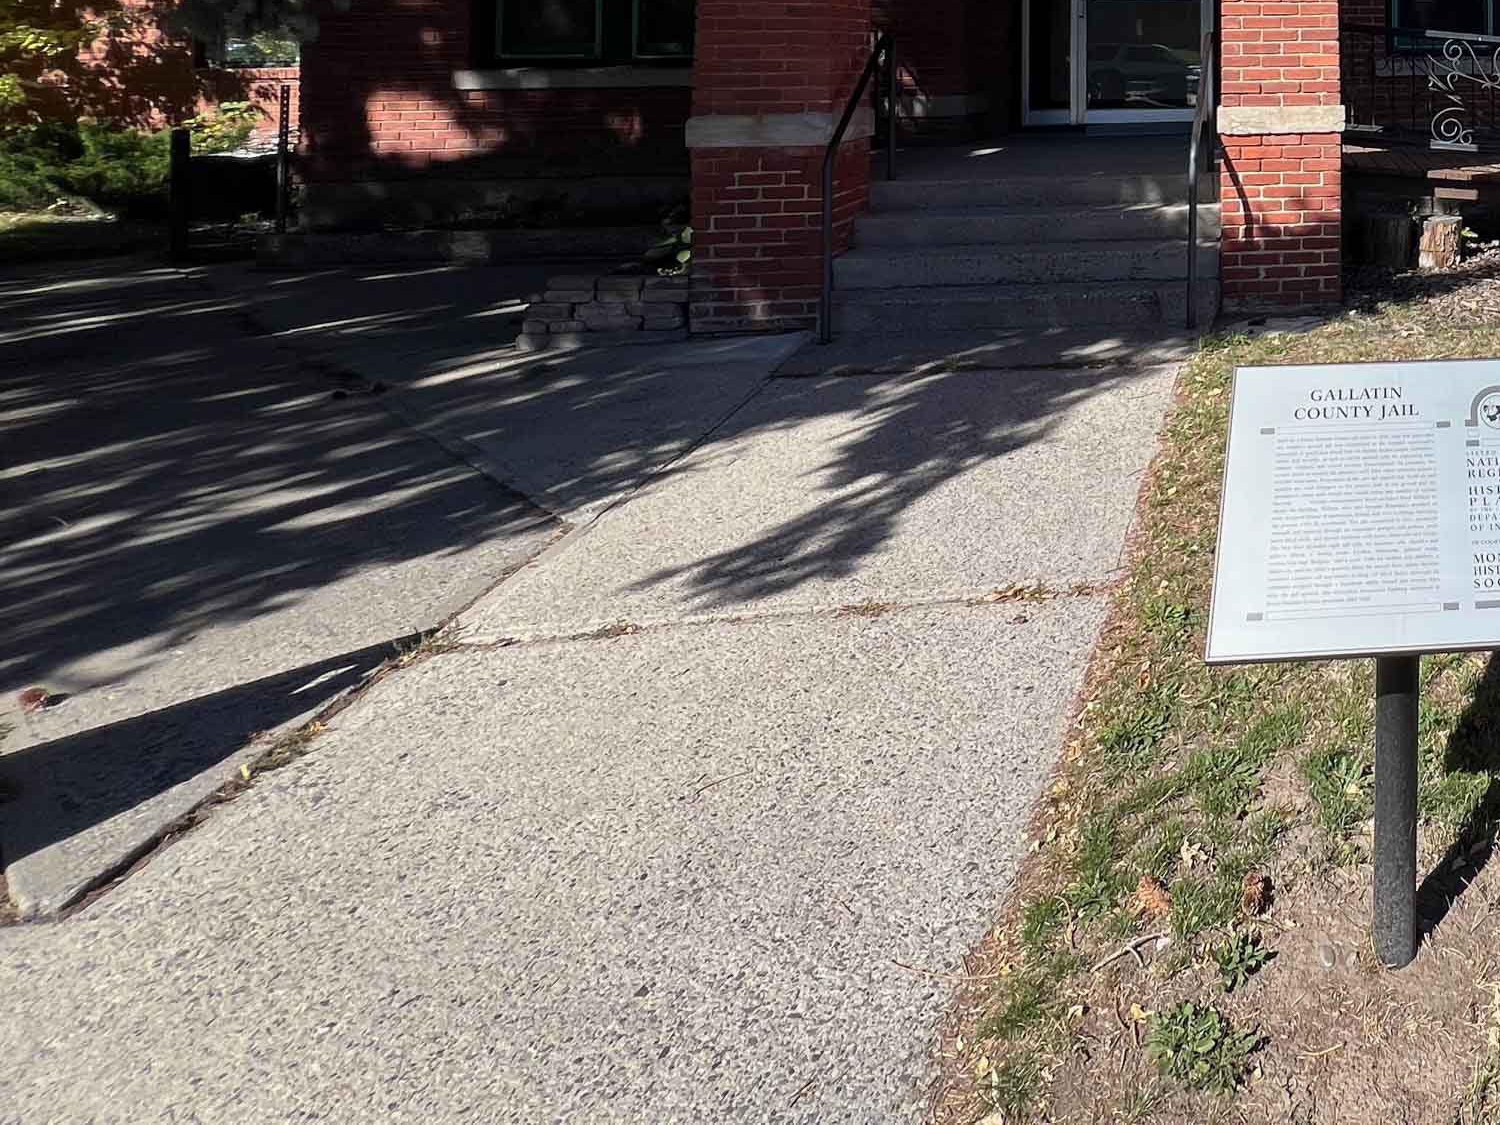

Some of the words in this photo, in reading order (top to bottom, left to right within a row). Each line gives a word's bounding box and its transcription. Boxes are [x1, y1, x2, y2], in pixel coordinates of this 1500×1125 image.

[1310, 386, 1402, 402] GALLATIN
[1294, 405, 1375, 420] COUNTY
[1378, 403, 1420, 421] JAIL
